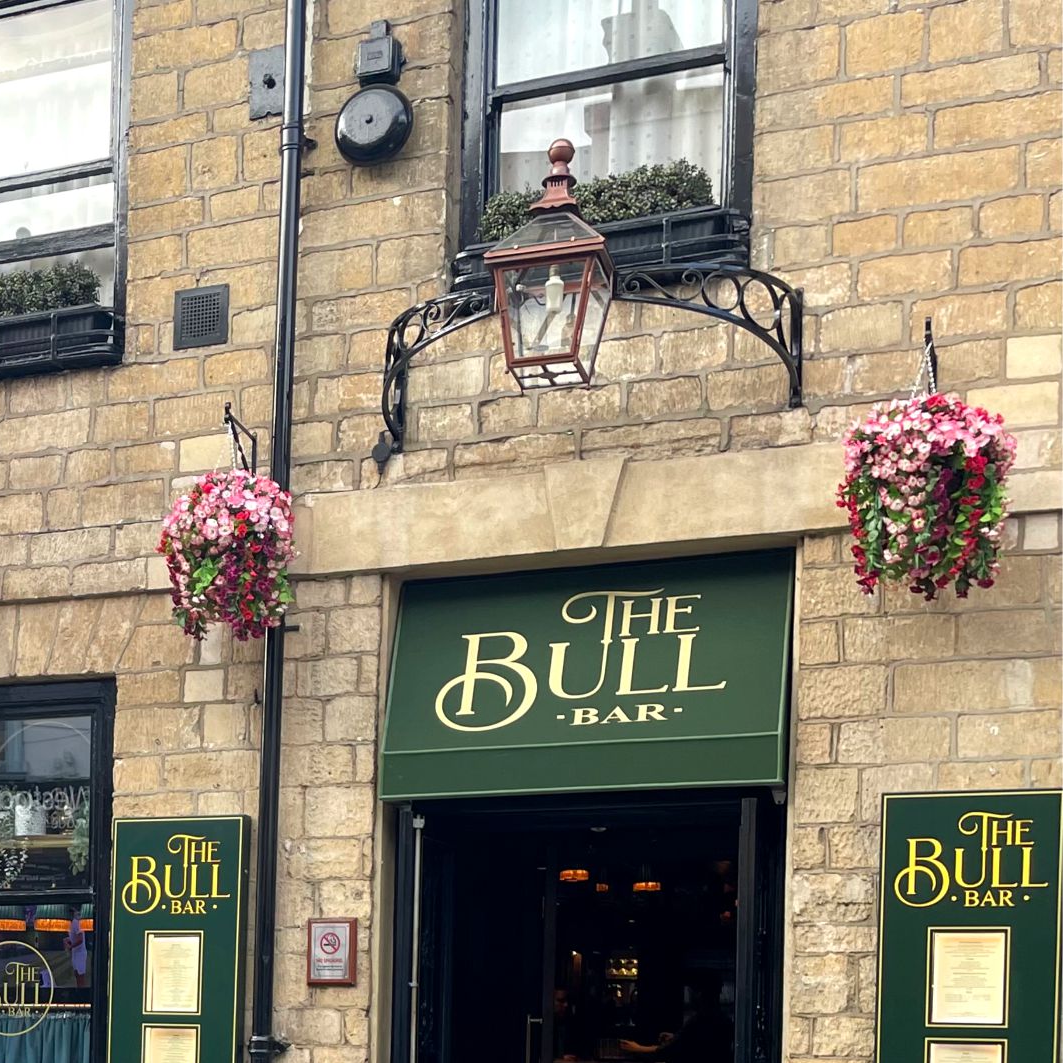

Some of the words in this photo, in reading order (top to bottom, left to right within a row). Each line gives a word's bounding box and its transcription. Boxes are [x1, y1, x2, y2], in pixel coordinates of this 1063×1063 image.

[561, 587, 702, 644] THE
[434, 630, 727, 732] BULL
[167, 834, 221, 867] THE
[958, 811, 1035, 851] THE
[121, 856, 231, 914] BULL
[894, 837, 1049, 908] BULL
[5, 961, 41, 985] THE
